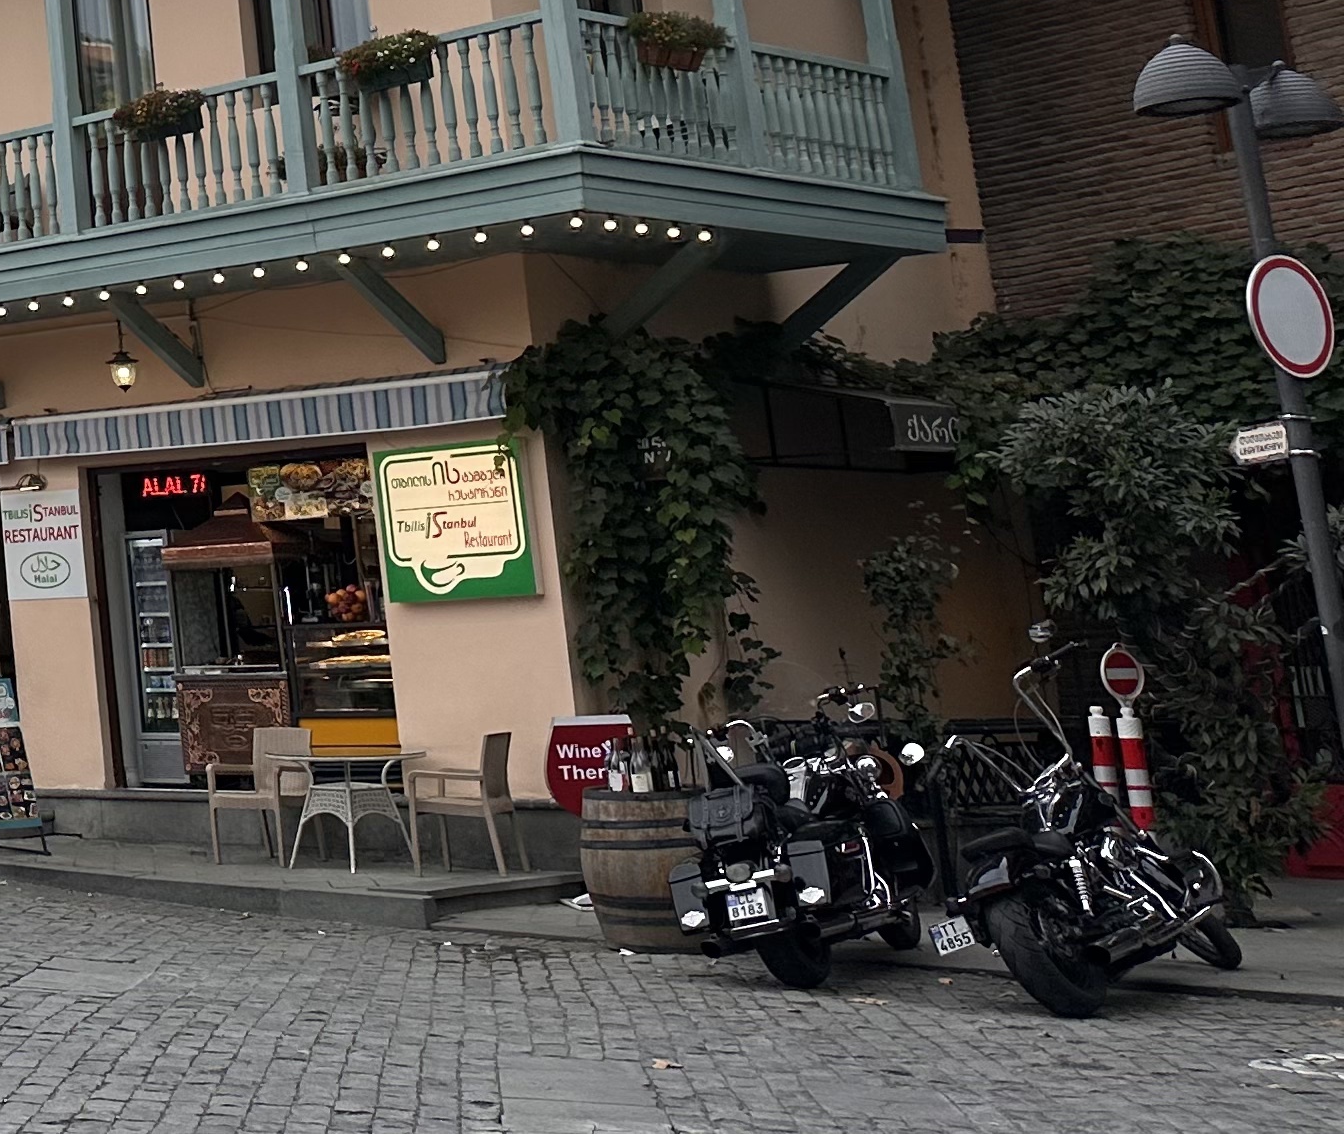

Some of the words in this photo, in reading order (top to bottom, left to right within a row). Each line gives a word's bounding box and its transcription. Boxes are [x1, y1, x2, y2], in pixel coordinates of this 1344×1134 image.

[5, 525, 79, 544] RESTAURANT
[464, 529, 513, 548] Restaurant
[30, 555, 61, 573] حلال
[34, 574, 58, 584] Halal
[556, 744, 602, 759] Wine
[558, 765, 608, 781] Ther
[732, 902, 764, 918] 8183
[940, 921, 957, 937] TT
[940, 931, 972, 952] 4855
